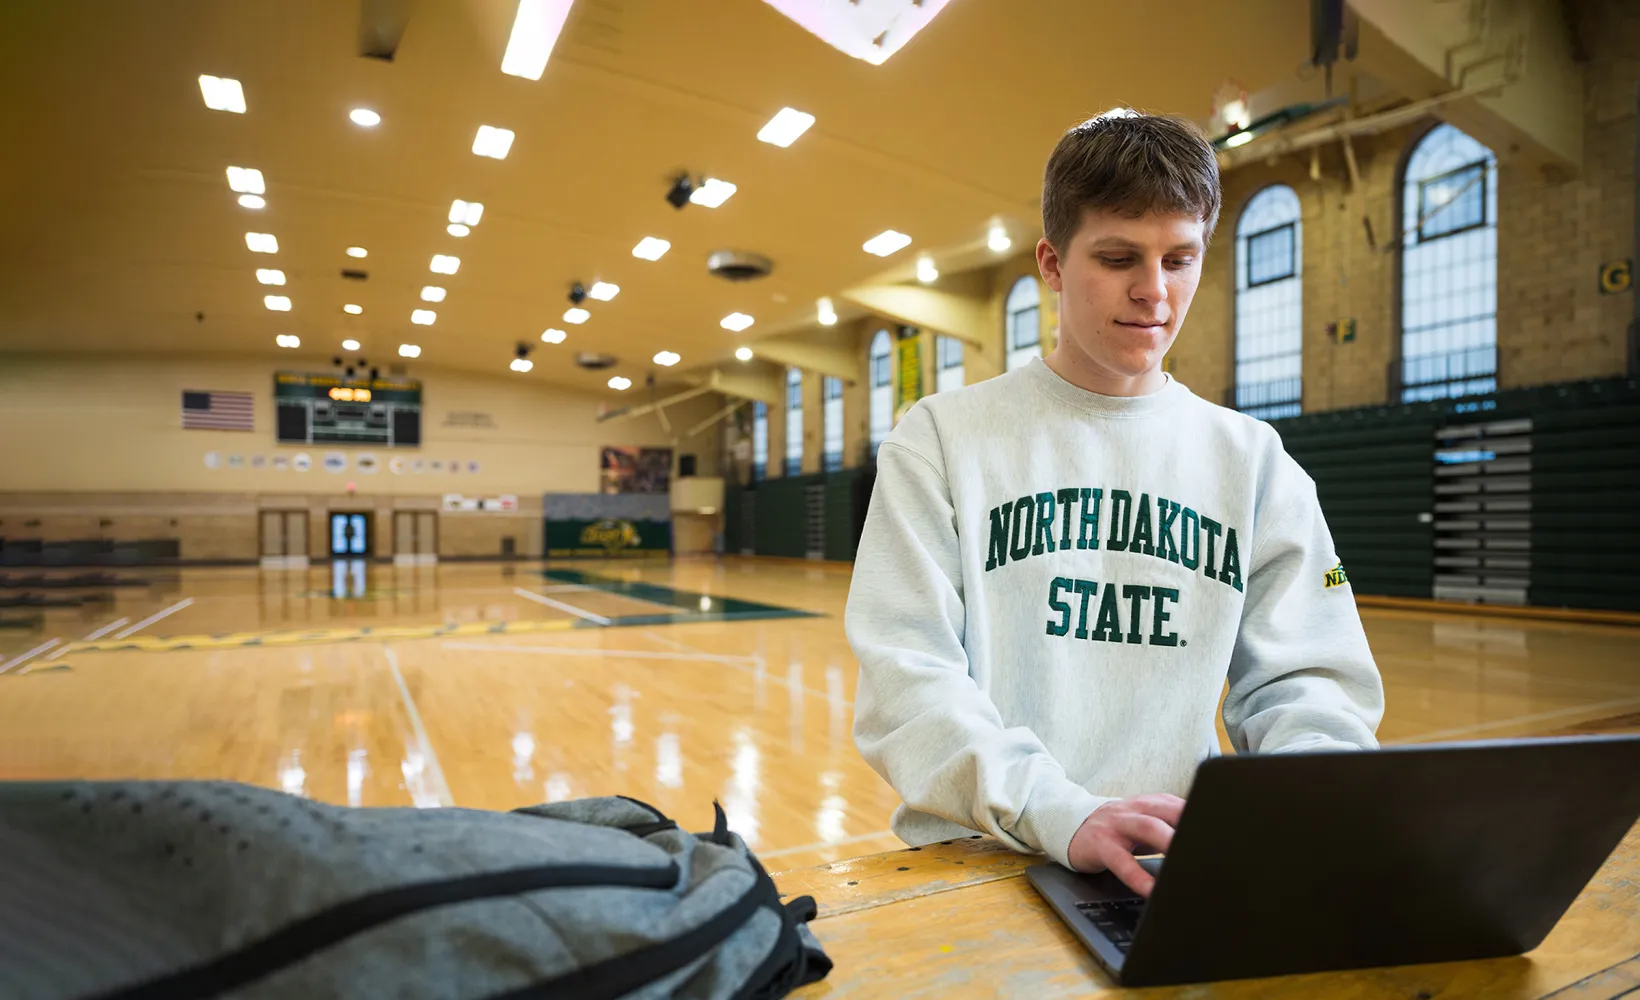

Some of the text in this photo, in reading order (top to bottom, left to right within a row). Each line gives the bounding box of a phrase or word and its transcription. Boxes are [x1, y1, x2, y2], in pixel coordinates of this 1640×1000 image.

[1603, 262, 1630, 292] G
[985, 487, 1244, 593] NORTH DAKOTA
[1046, 576, 1179, 647] STATE
